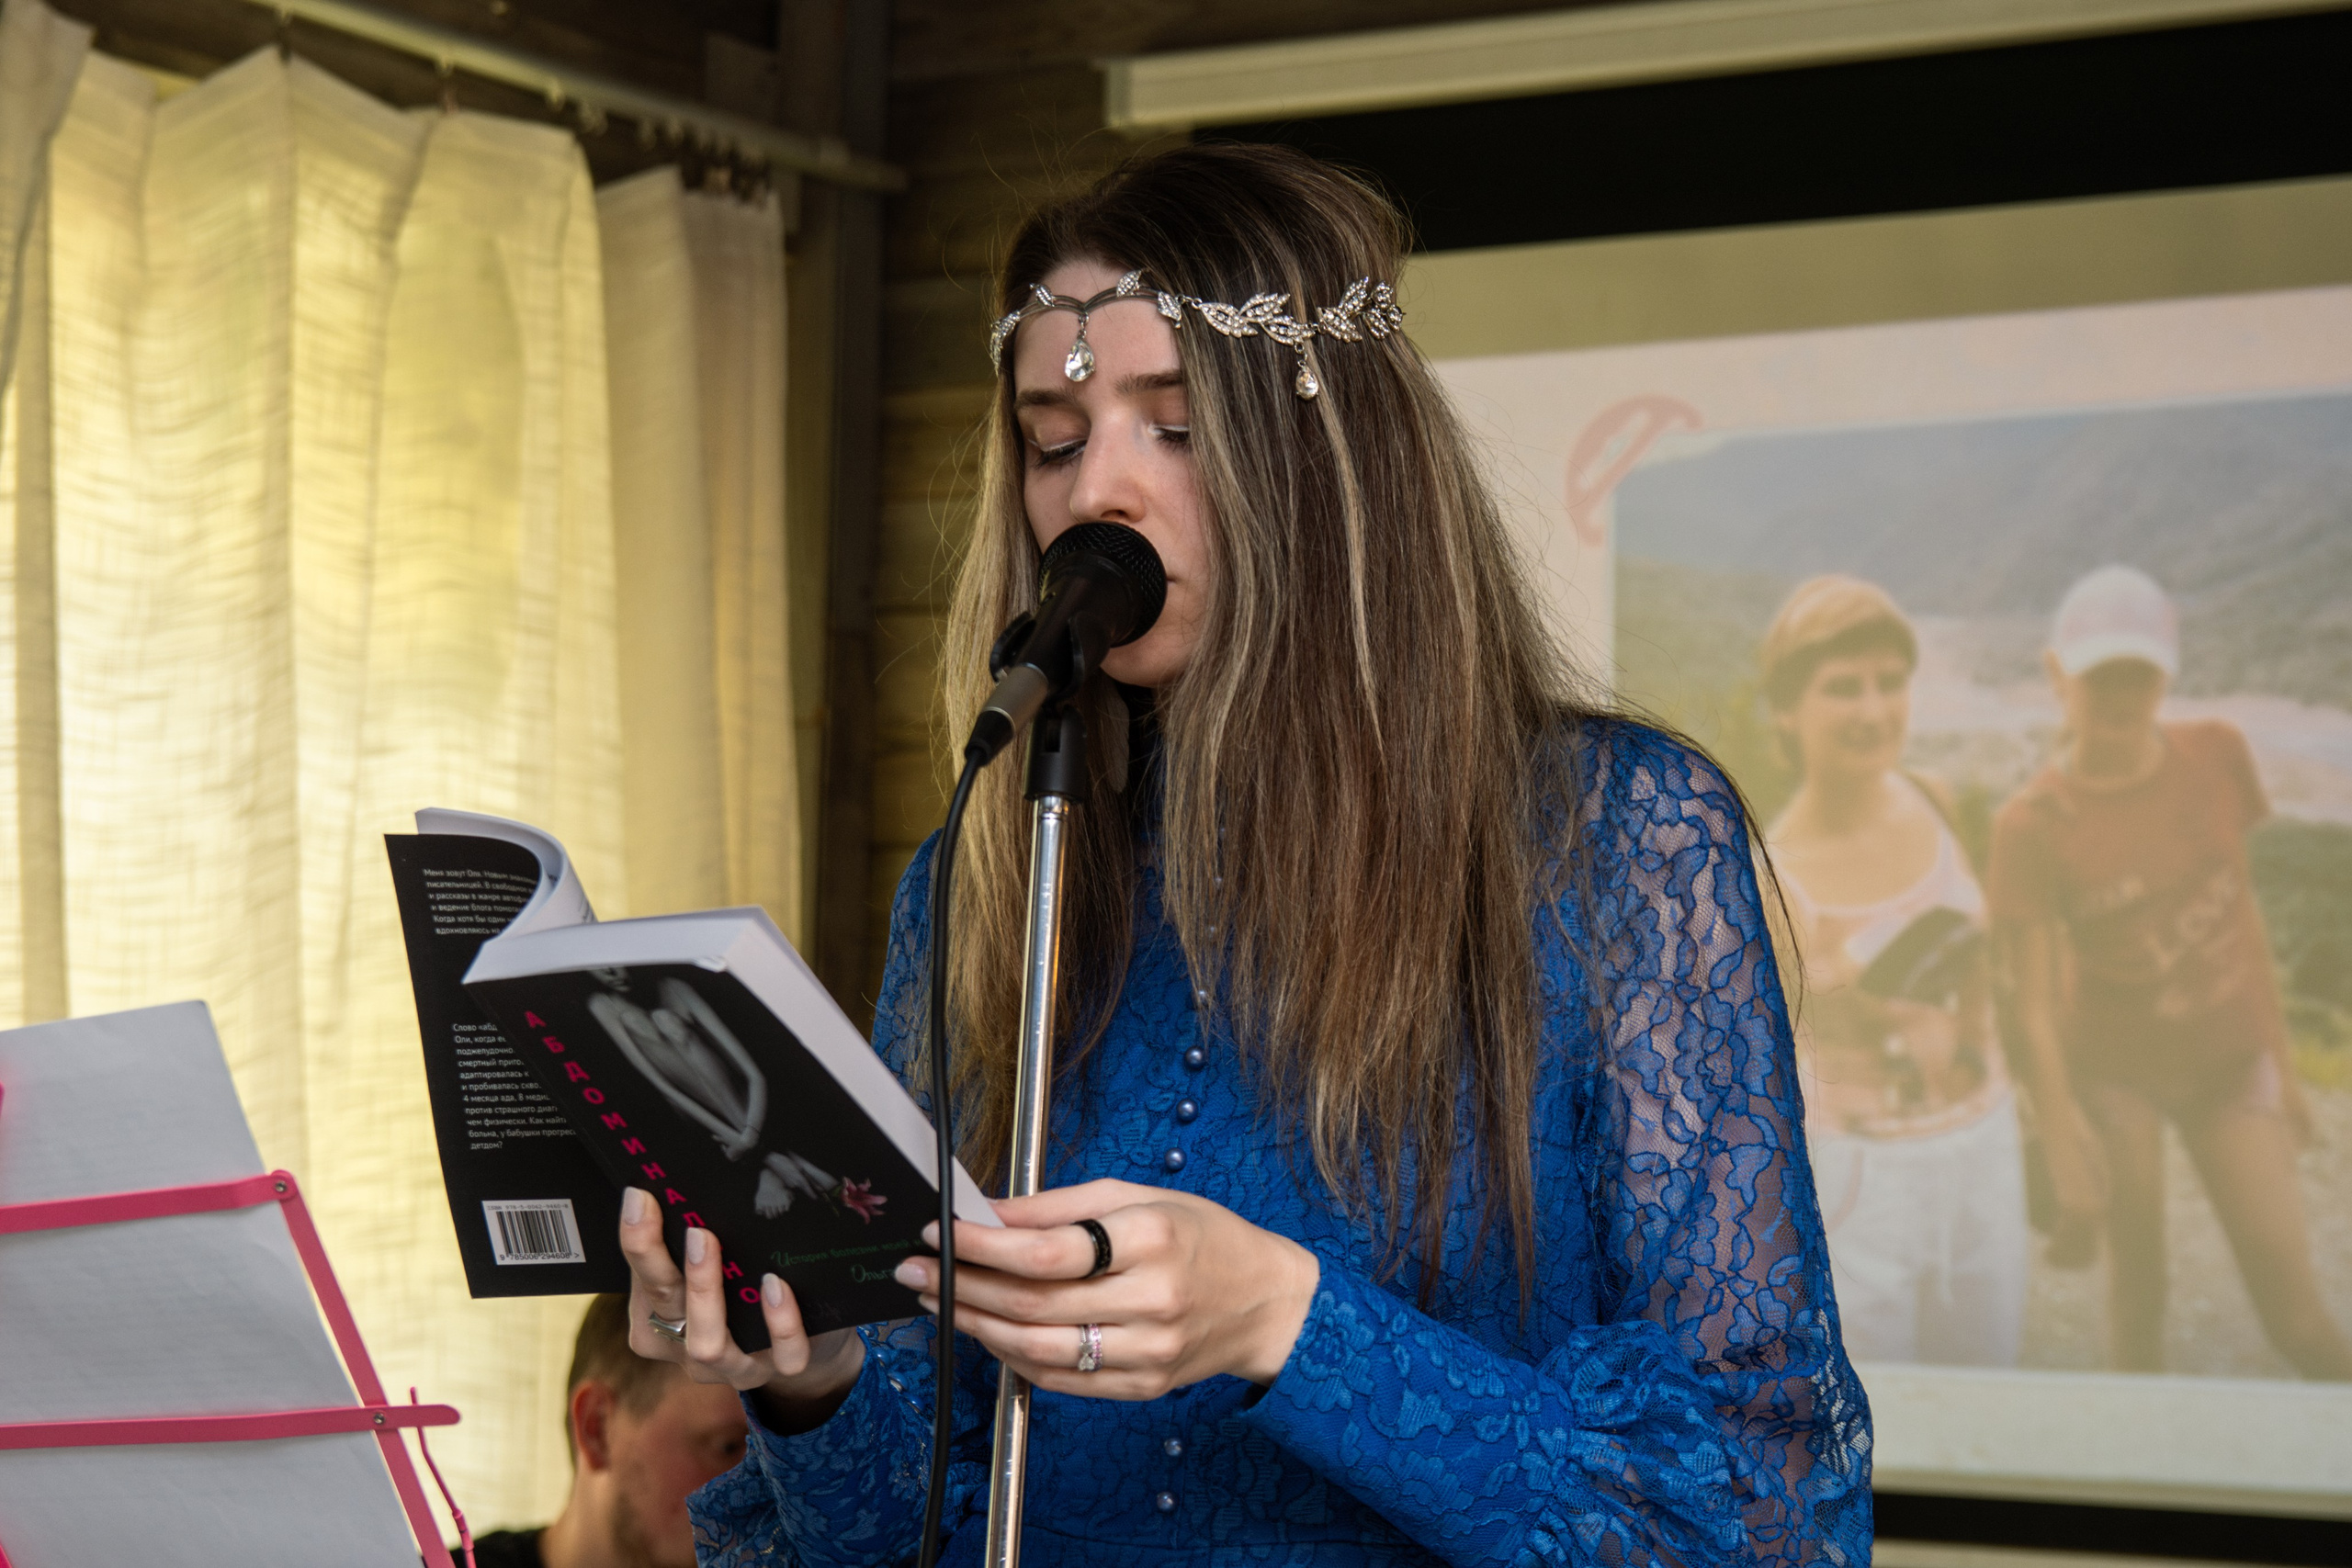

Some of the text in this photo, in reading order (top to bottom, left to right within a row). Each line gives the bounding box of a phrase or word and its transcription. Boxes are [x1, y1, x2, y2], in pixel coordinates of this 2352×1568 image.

[424, 869, 444, 877] Меня
[446, 870, 465, 878] зовут
[492, 882, 526, 892] свободное
[435, 893, 470, 901] рассказы
[438, 904, 469, 912] ведение
[471, 903, 492, 911] блога
[434, 915, 456, 923] Когда
[435, 926, 490, 935] вдохновляюсь
[453, 1023, 477, 1032] Слово
[457, 1047, 514, 1055] поджелудочно
[458, 1059, 524, 1067] смертный приго
[460, 1072, 523, 1080] адаптировалась
[469, 1082, 519, 1091] пробивалась
[465, 1107, 492, 1115] против
[494, 1105, 536, 1114] страшного
[506, 1128, 540, 1137] бабушки
[470, 1141, 503, 1150] детдом?
[524, 1010, 761, 1304] АБДОМИНАЛНО
